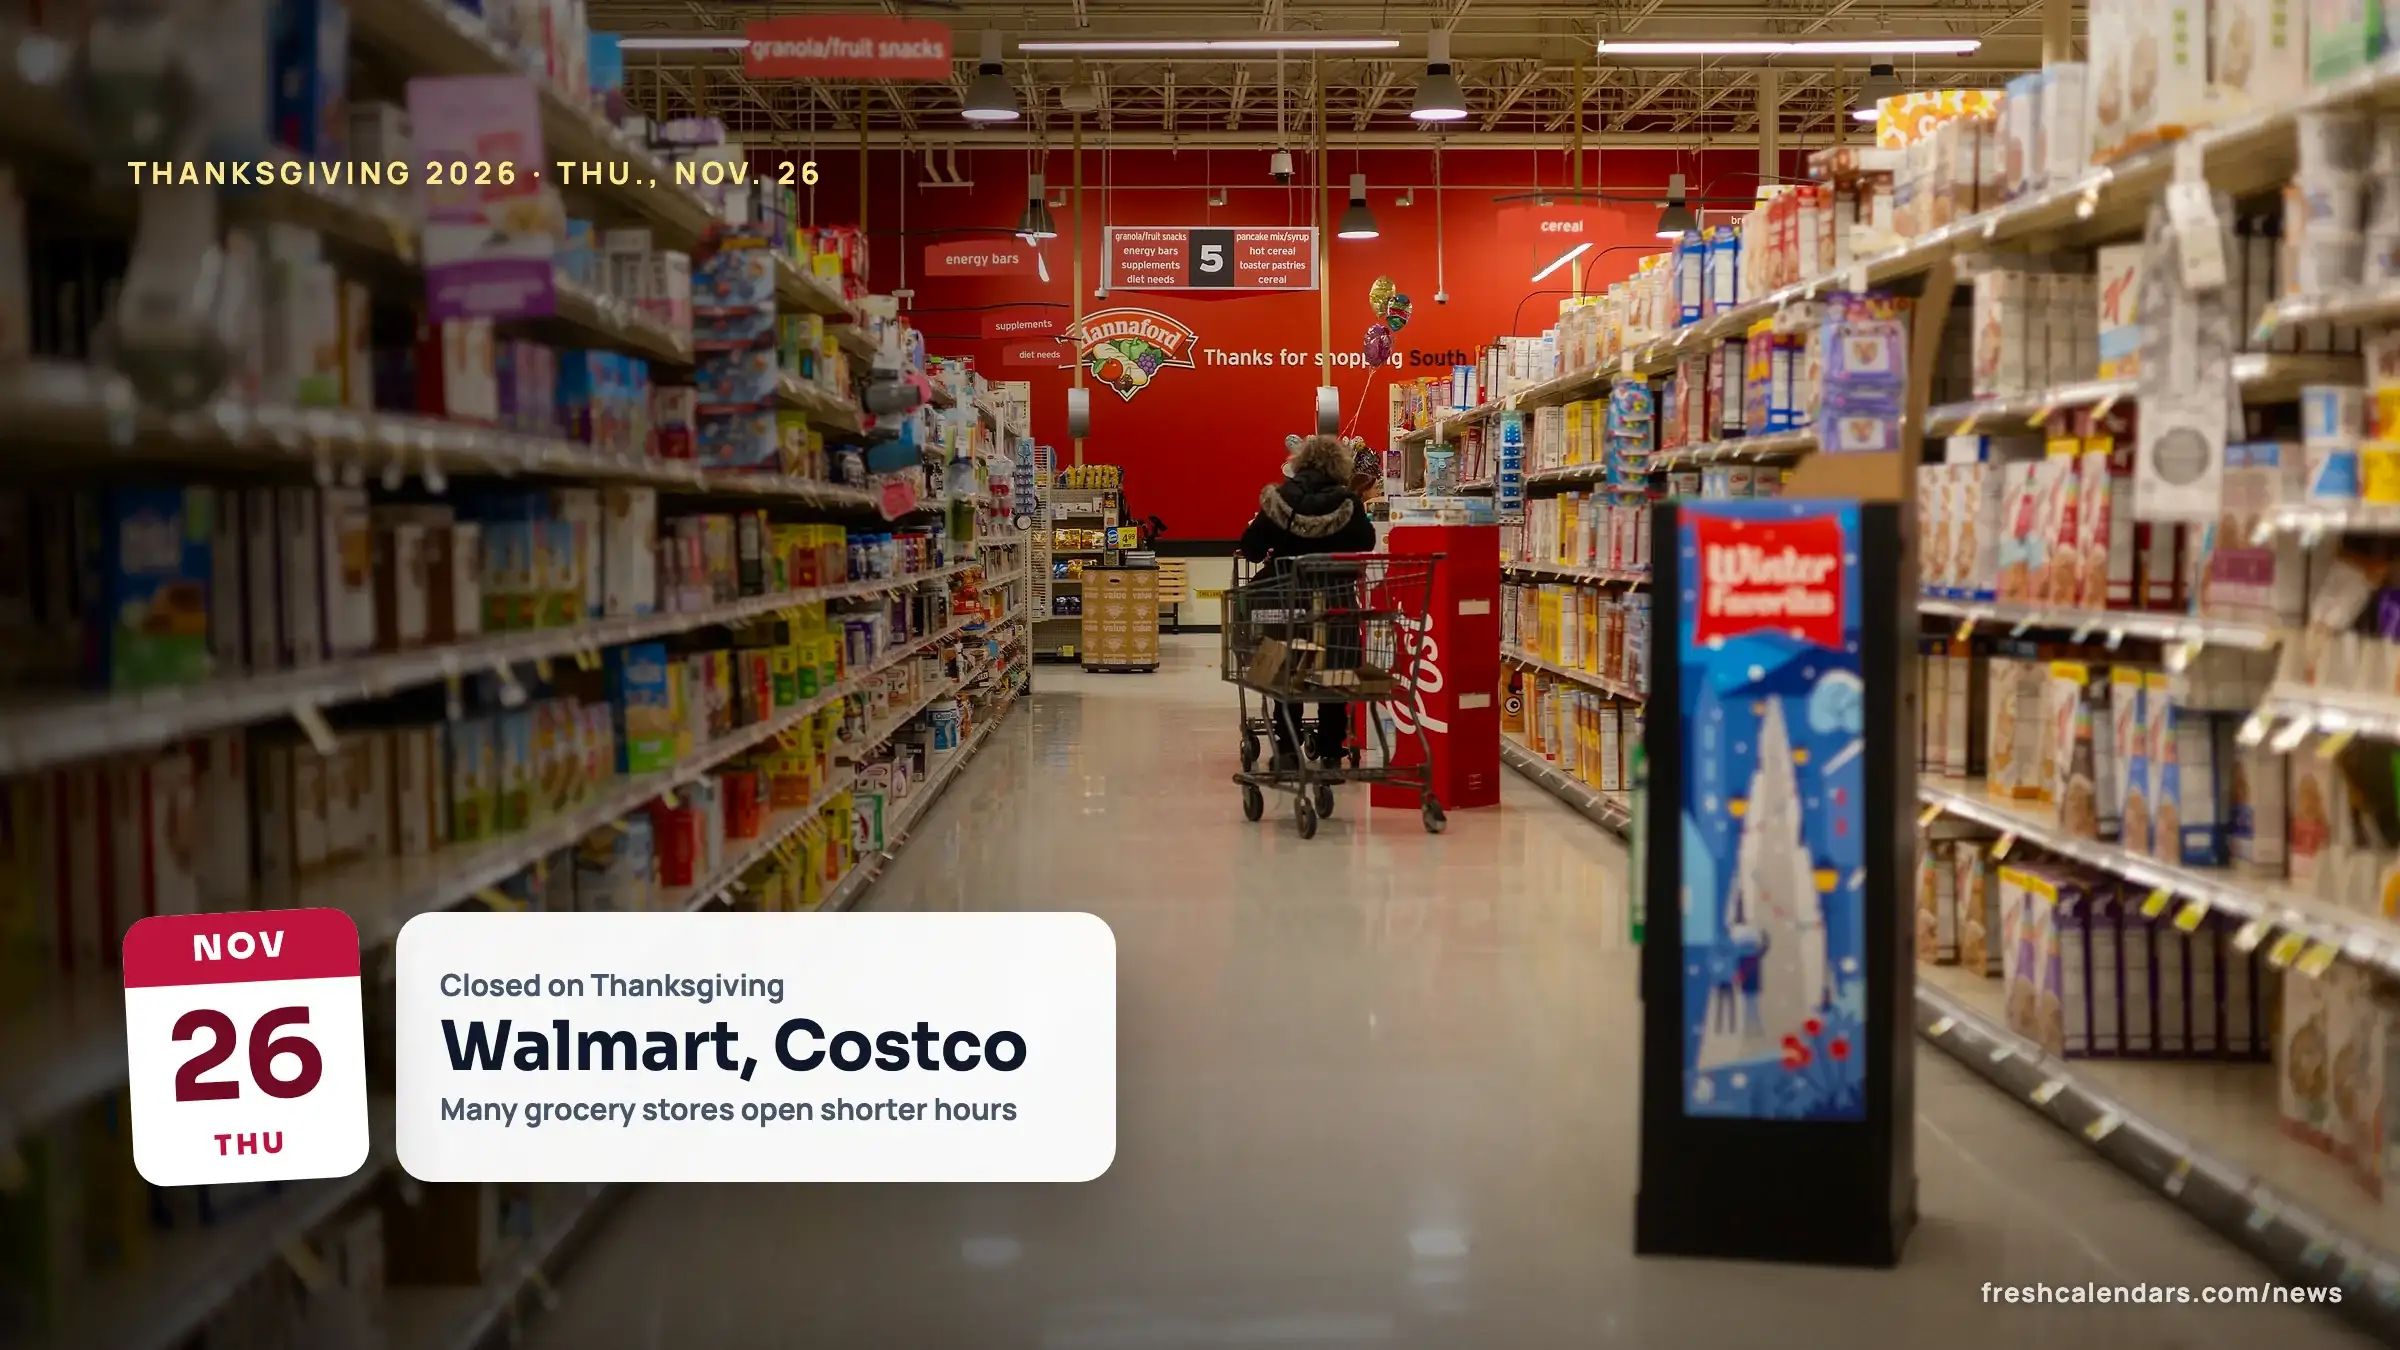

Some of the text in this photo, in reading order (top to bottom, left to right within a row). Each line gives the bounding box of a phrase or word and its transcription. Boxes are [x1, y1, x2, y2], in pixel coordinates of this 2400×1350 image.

[752, 36, 944, 61] granola/fruit snacks
[1540, 219, 1584, 233] cereal
[1115, 232, 1187, 242] granola/fruit snacks
[1236, 232, 1310, 242] pancake mix/syrup
[1123, 246, 1179, 257] energy bars
[1249, 246, 1296, 255] hot cereal
[945, 253, 1019, 268] energy bars
[1199, 244, 1224, 273] 5
[1121, 260, 1181, 270] supplements
[1239, 261, 1306, 270] toaster pastries
[1126, 274, 1175, 284] diet needs
[1258, 274, 1287, 284] cereal
[995, 319, 1053, 332] supplements
[1019, 350, 1061, 359] diet needs
[1203, 348, 1273, 366] Thanks
[1280, 348, 1308, 366] for
[1410, 349, 1467, 366] South
